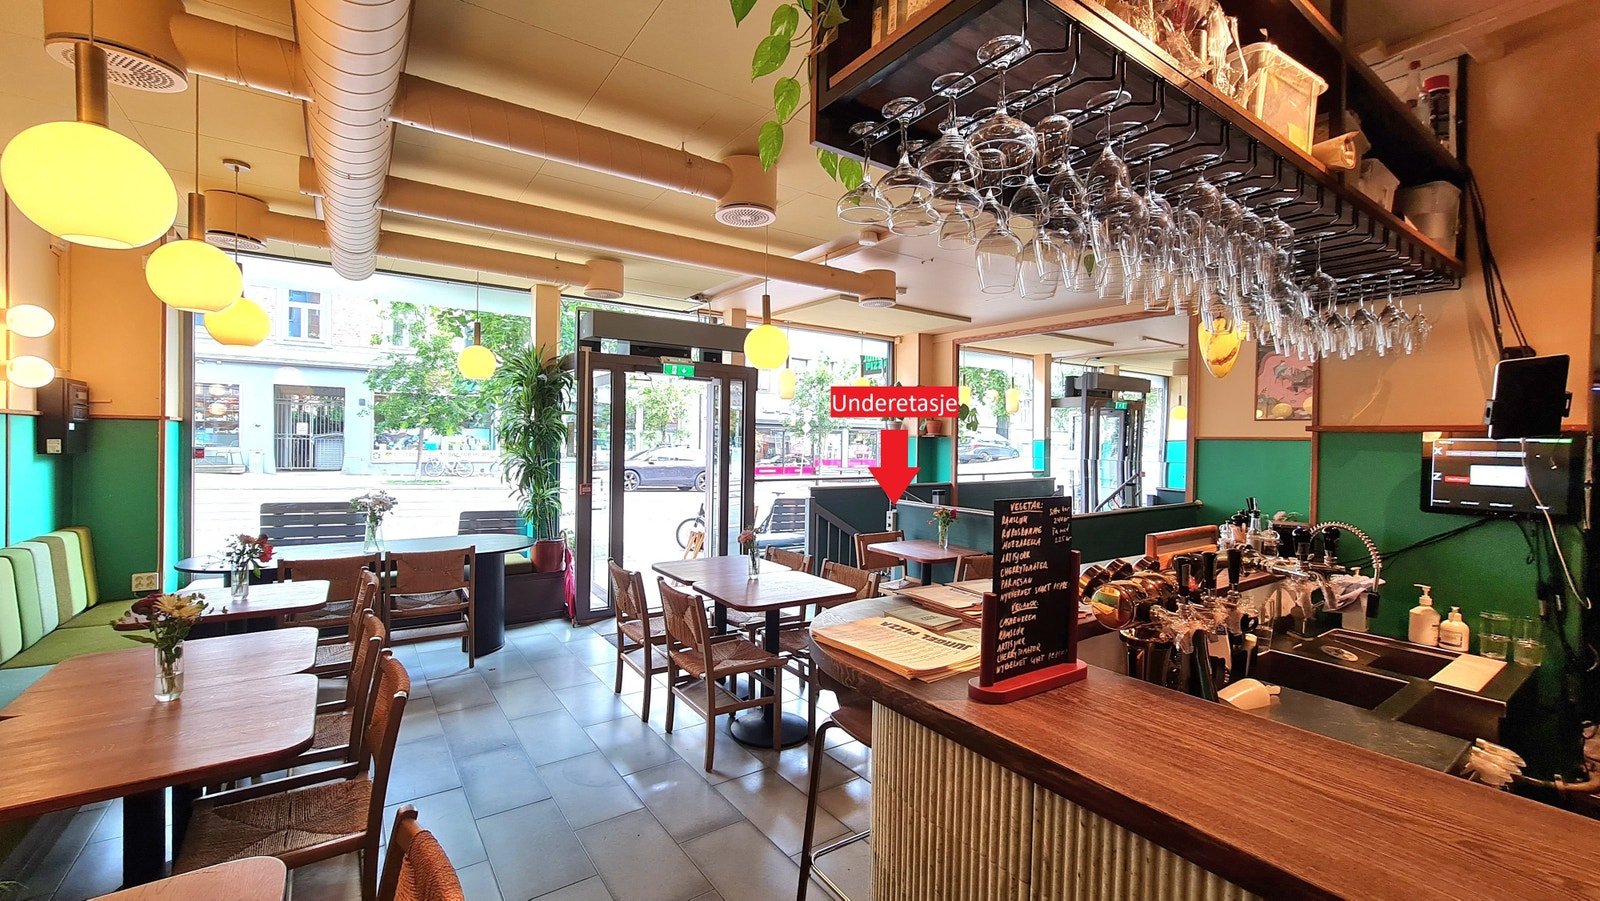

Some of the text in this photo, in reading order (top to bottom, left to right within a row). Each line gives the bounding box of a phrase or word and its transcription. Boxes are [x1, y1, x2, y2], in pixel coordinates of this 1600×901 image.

[1001, 537, 1041, 550] MOZZARELLA
[1001, 577, 1033, 590] PARMESAN
[880, 621, 921, 636] PIZZA
